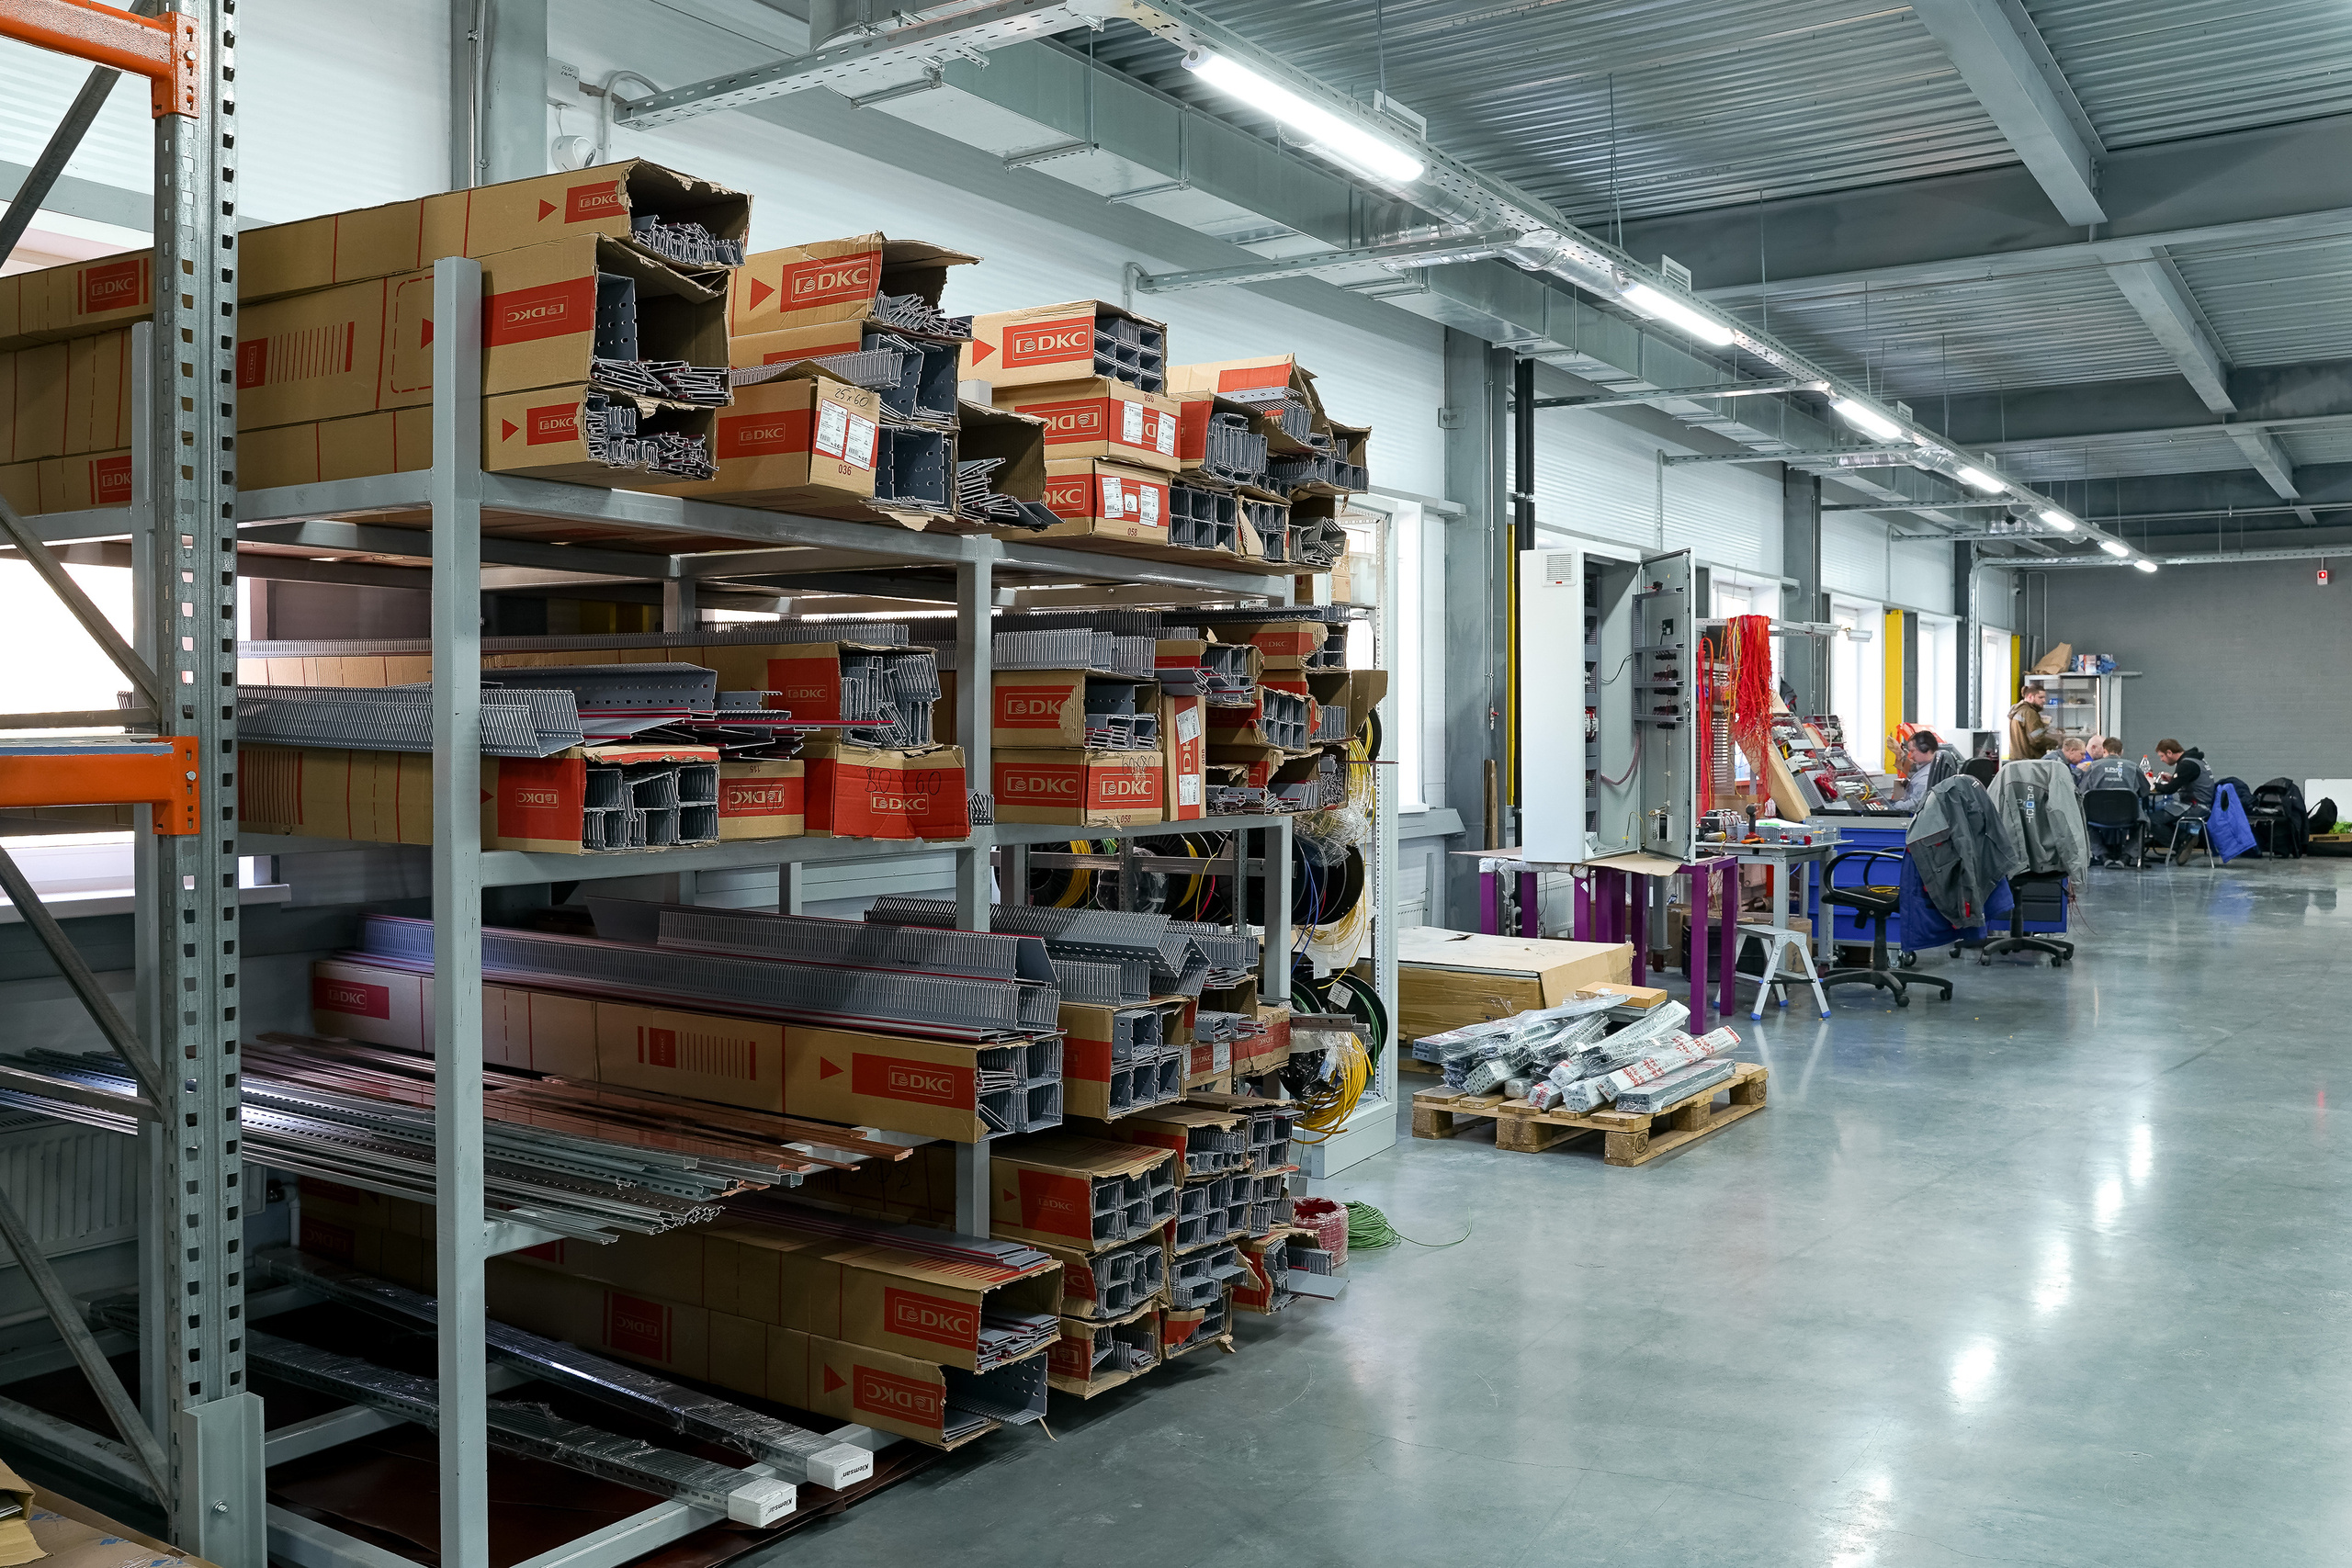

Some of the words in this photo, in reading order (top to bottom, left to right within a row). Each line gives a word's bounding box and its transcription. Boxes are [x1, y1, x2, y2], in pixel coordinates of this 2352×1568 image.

[592, 194, 617, 207] DKC
[104, 276, 134, 293] DKC
[817, 266, 871, 291] DKC
[507, 306, 547, 322] DKC
[1037, 331, 1087, 351] DKC
[551, 415, 574, 429] DKC
[1044, 414, 1075, 431] DK
[755, 426, 784, 439] DKC
[838, 464, 852, 476] 036
[114, 472, 131, 486] DK
[1127, 527, 1137, 536] 058
[800, 688, 826, 699] DKC
[1029, 700, 1061, 715] DK
[1182, 740, 1192, 773] DK
[1029, 778, 1077, 794] DKC
[1117, 780, 1152, 795] DKC
[517, 791, 546, 804] DKC
[730, 790, 765, 805] DKC
[888, 797, 928, 811] DKC
[1120, 814, 1131, 823] 058
[339, 989, 365, 1005] DKC
[910, 1075, 952, 1093] DKC
[1049, 1200, 1073, 1213] DKC
[616, 1316, 645, 1335] DKC
[922, 1308, 970, 1335] DKC
[865, 1382, 913, 1408] DKC
